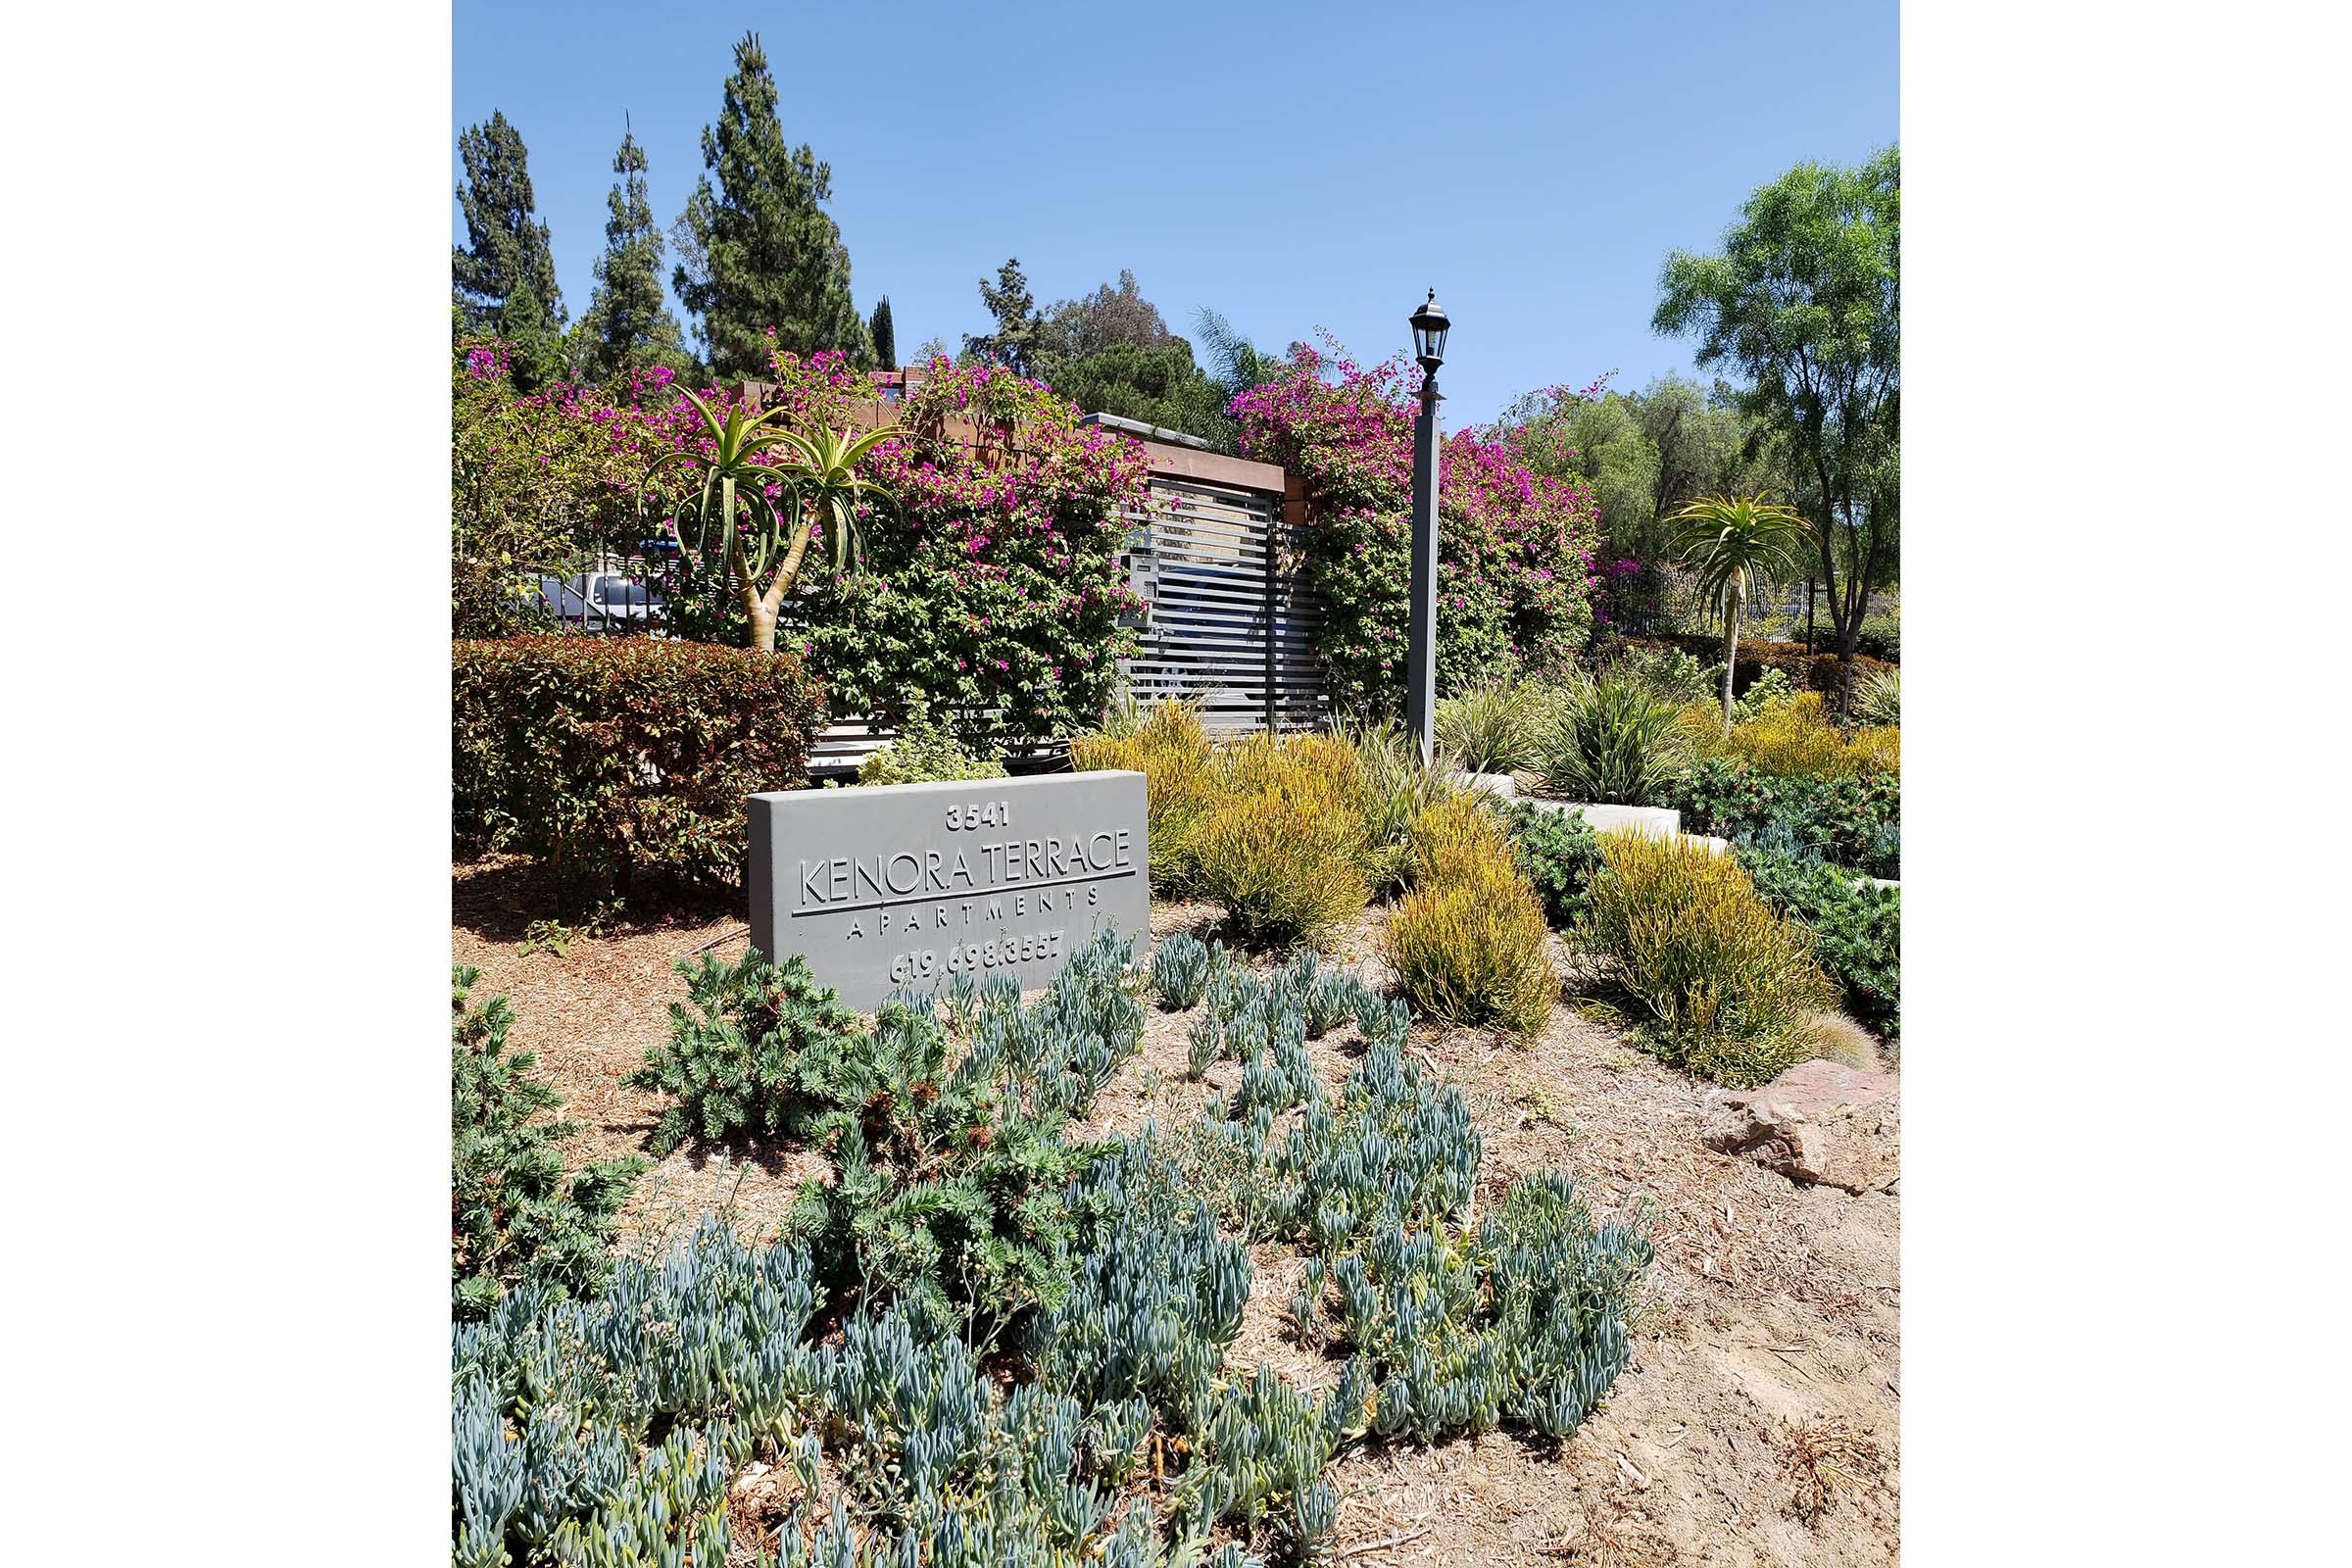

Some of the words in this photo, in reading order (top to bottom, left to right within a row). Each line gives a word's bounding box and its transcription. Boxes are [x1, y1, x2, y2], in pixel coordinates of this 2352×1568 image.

[946, 801, 1009, 832] 3541
[800, 846, 974, 906] KENORA
[981, 829, 1130, 883] TERRACE
[847, 885, 1099, 940] APARTMENTS
[890, 930, 1065, 984] 619.698.3557
